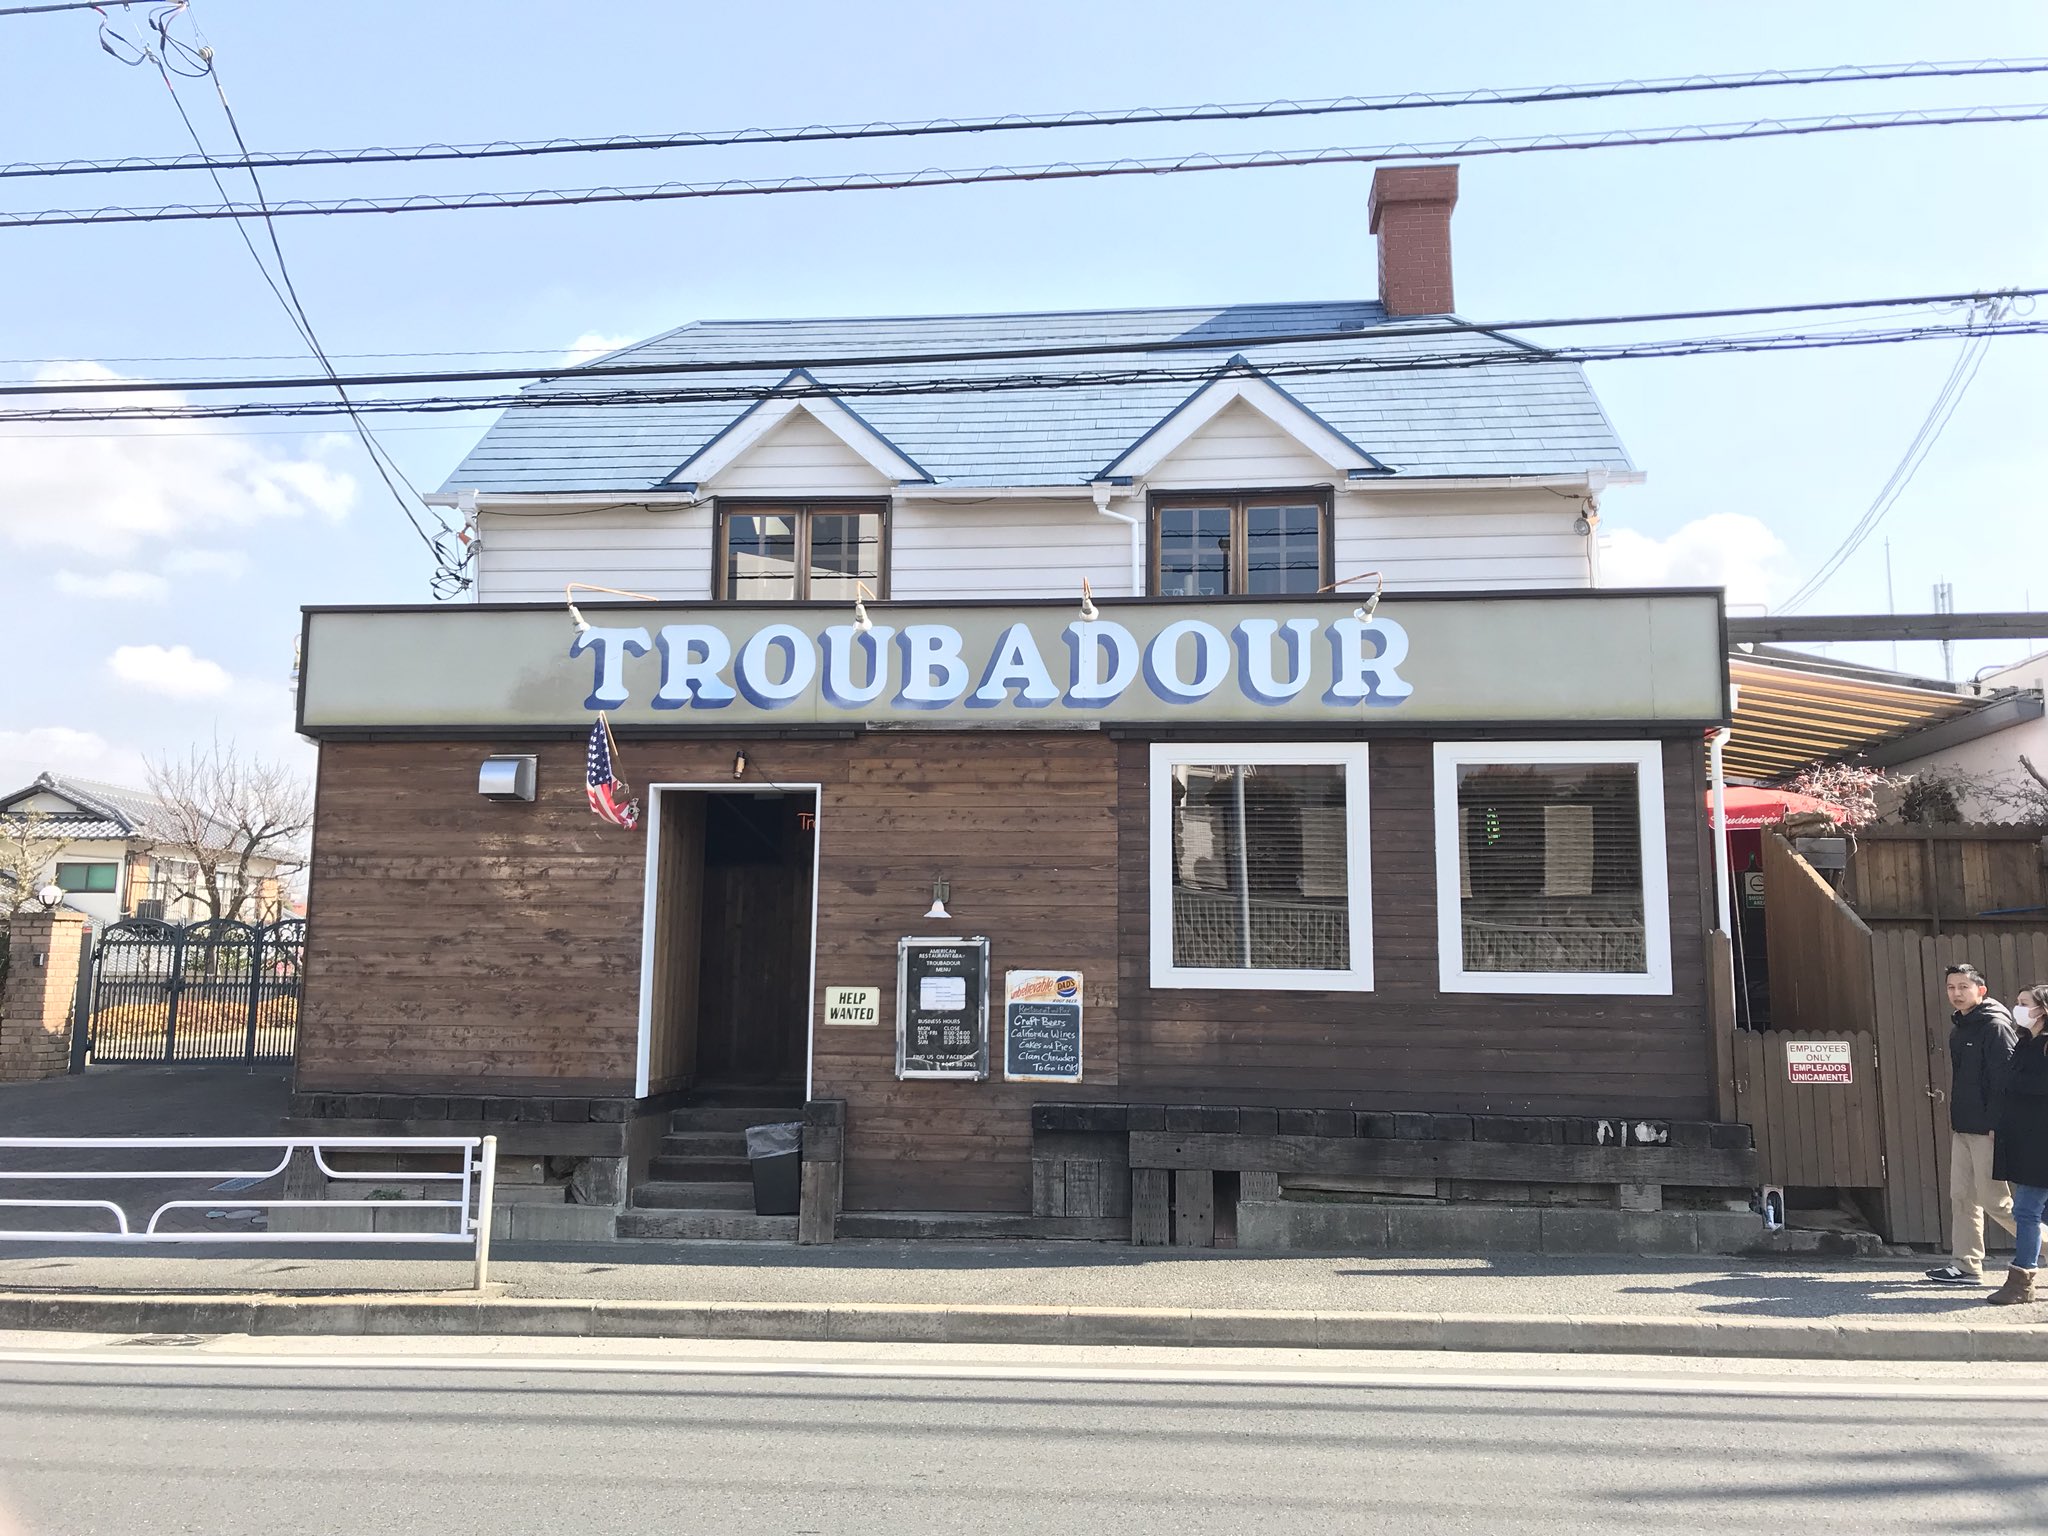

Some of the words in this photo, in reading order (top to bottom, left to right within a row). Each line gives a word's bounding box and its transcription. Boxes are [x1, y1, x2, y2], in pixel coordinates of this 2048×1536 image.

[569, 617, 1414, 710] TROUBADOUR
[838, 992, 867, 1005] HELP
[830, 1007, 874, 1020] WANTED
[1014, 1015, 1040, 1026] Craft
[1041, 1016, 1066, 1027] Beers
[1011, 1028, 1049, 1039] California
[1050, 1029, 1076, 1039] Wines
[1018, 1041, 1042, 1049] Cakes
[1054, 1041, 1073, 1051] Pies
[1790, 1044, 1847, 1053] EMPLOYEES
[1018, 1051, 1040, 1061] Clam
[1806, 1053, 1832, 1061] ONLY
[1793, 1063, 1847, 1072] EMPLEADOS
[1792, 1073, 1849, 1082] UNICAMENTE
